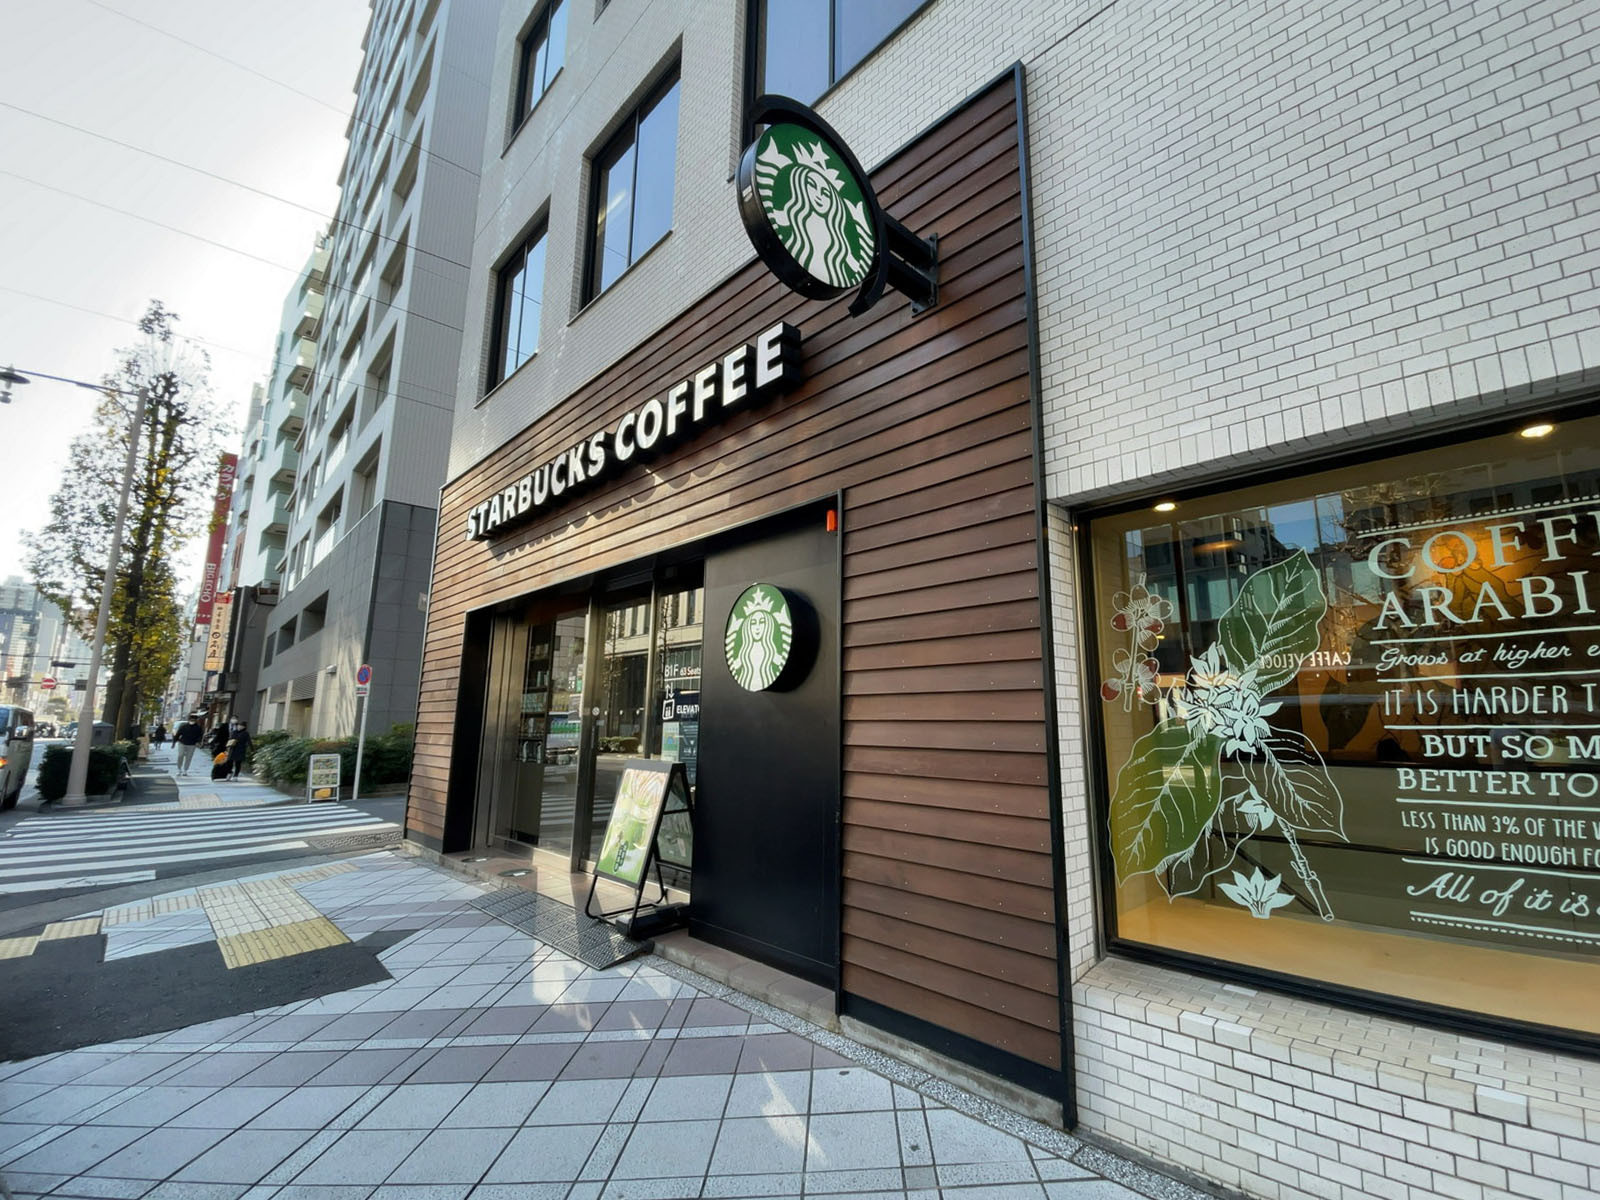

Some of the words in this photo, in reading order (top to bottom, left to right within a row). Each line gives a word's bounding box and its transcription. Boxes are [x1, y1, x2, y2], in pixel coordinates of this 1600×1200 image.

[465, 431, 605, 540] STARBUCKS
[614, 321, 785, 461] COFFEE
[1372, 570, 1597, 631] ARABI
[1376, 647, 1449, 671] Grows
[1459, 648, 1488, 664] at
[1492, 641, 1572, 669] higher
[1384, 689, 1404, 716] IT
[1416, 689, 1439, 715] IS
[1452, 685, 1569, 715] HARDER
[1581, 683, 1597, 712] T
[1422, 734, 1492, 758] BUT
[1501, 735, 1554, 759] SO
[1565, 735, 1600, 759] M
[1396, 768, 1536, 796] BETTER
[1540, 772, 1599, 798] TO
[1401, 810, 1436, 830] LESS
[1442, 812, 1486, 833] THAN
[1492, 815, 1521, 835] 3%
[1524, 818, 1549, 837] OF
[1552, 818, 1588, 840] THE
[1425, 837, 1439, 855] IS
[1446, 839, 1495, 860] GOOD
[1502, 843, 1577, 867] ENOUGH
[1406, 872, 1475, 902] All
[1480, 878, 1525, 916] of
[1524, 887, 1553, 911] it
[1560, 891, 1590, 916] is
